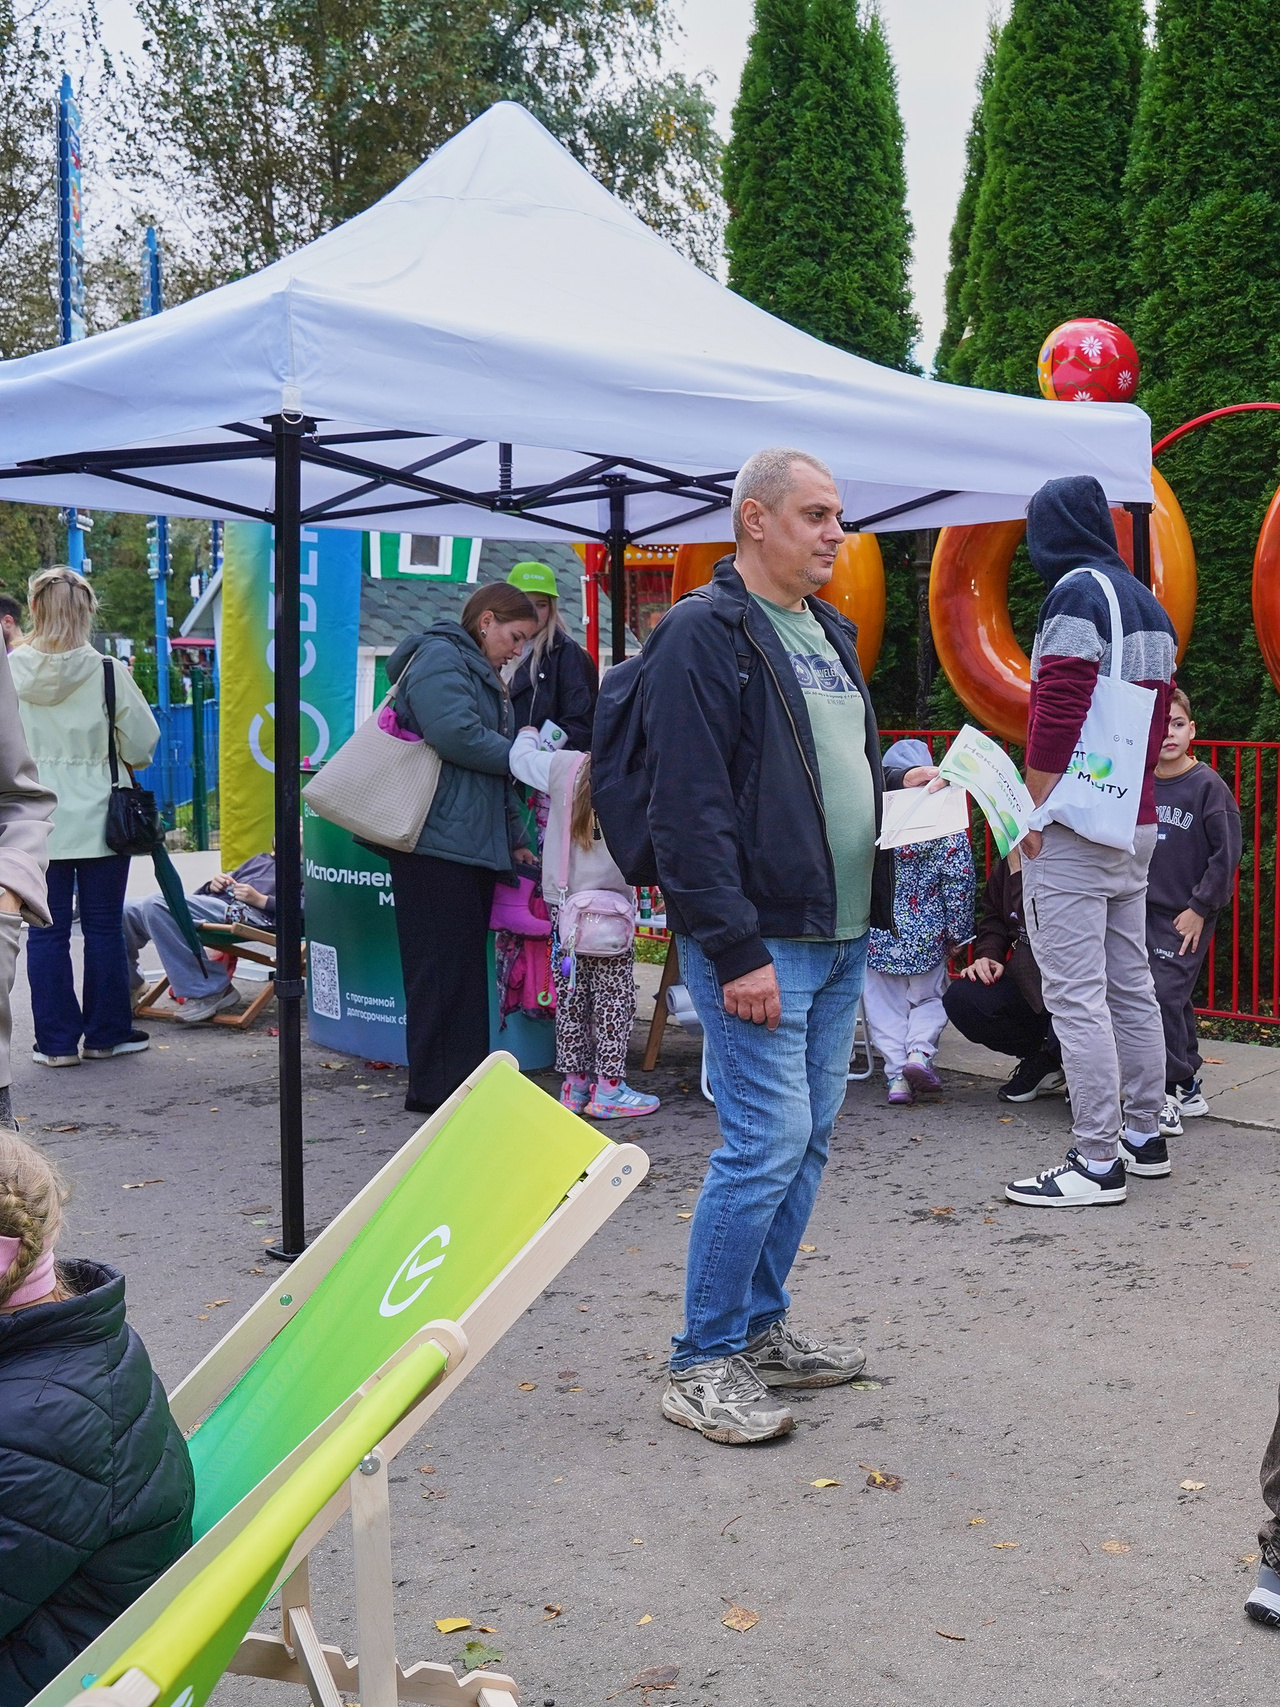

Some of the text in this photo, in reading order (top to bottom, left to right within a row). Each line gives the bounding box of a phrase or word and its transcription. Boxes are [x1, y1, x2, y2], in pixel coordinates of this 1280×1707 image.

[1077, 771, 1129, 799] мчту
[1156, 805, 1194, 830] VARD
[350, 992, 396, 1008] программой
[346, 1007, 397, 1025] долгосрочных
